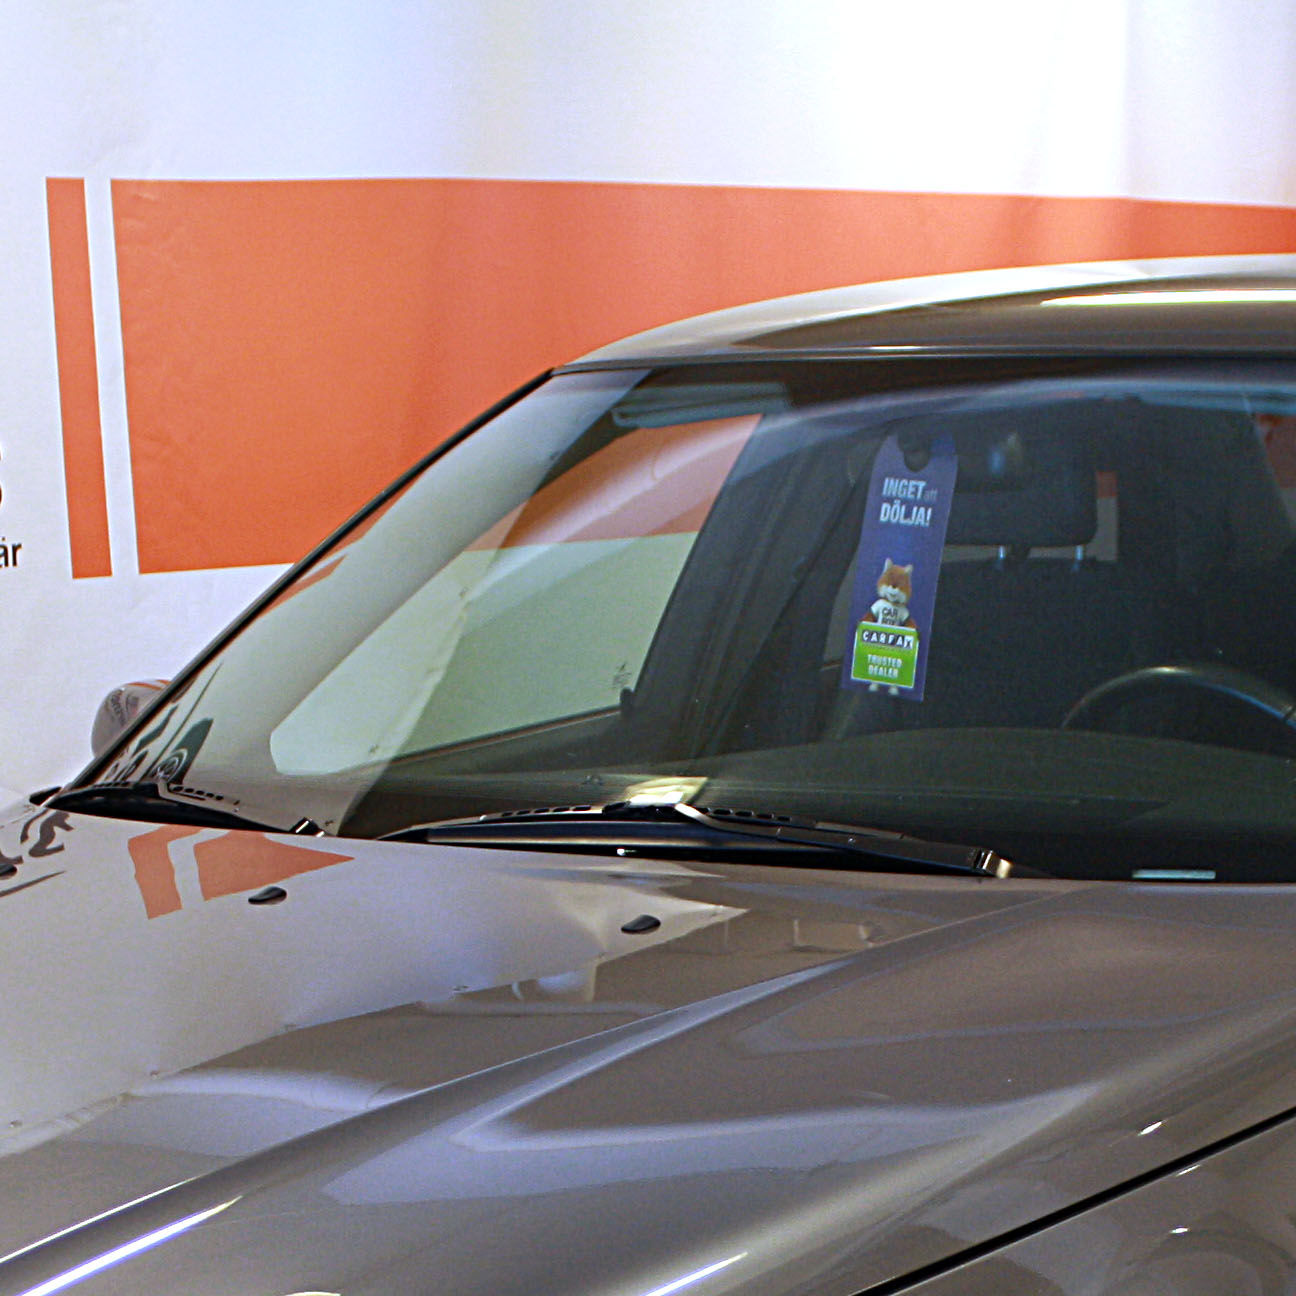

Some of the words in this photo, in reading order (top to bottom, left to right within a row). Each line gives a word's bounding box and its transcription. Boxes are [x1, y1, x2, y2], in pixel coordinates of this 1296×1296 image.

[882, 477, 926, 500] INGET
[879, 499, 932, 527] DÖLJA!
[862, 630, 914, 650] CARFAX
